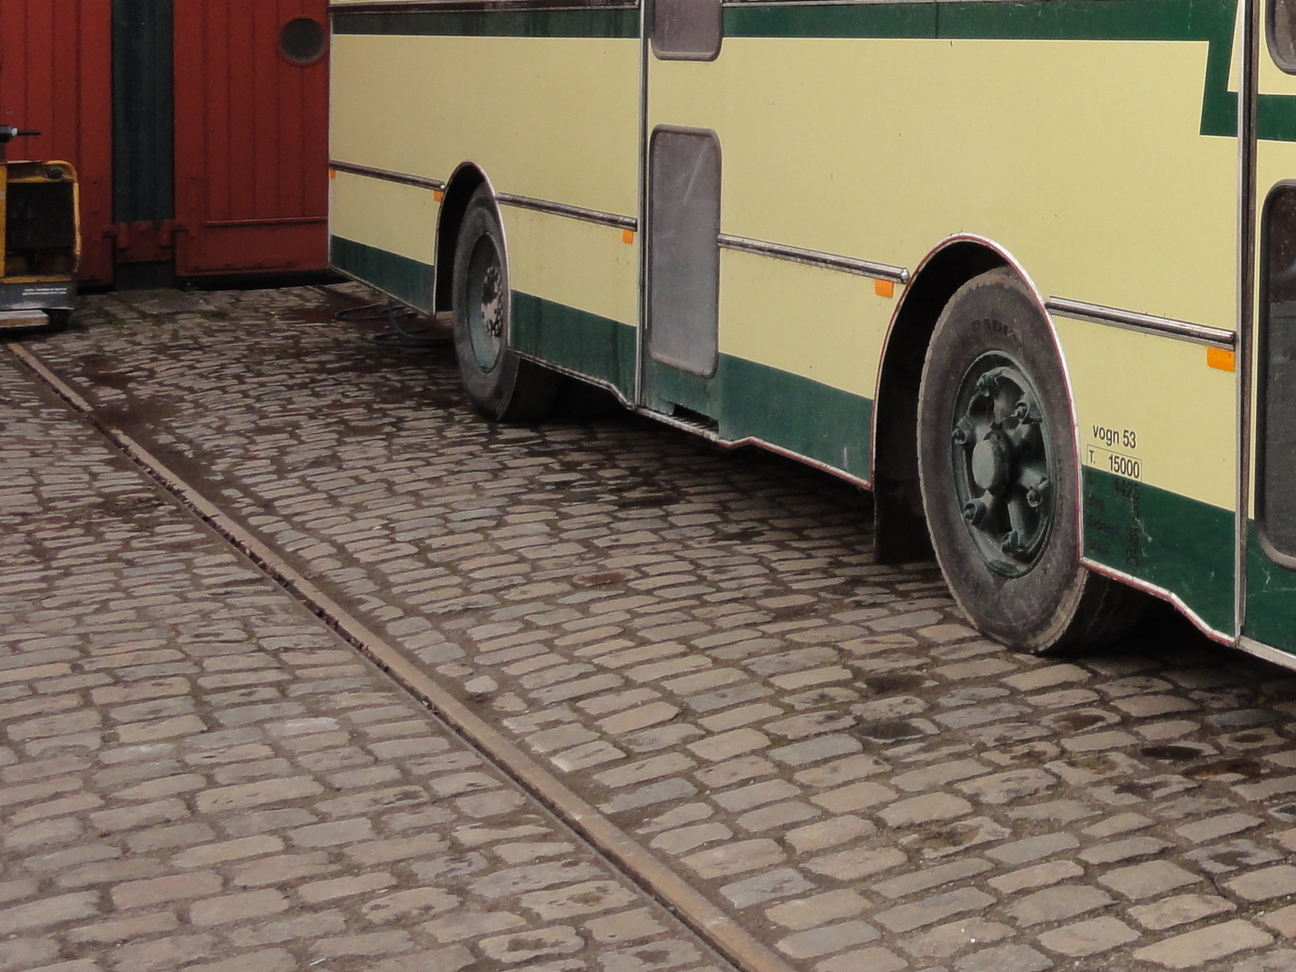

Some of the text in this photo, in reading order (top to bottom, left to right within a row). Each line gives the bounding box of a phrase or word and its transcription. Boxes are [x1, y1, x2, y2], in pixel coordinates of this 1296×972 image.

[1092, 424, 1137, 449] vogn 53
[1108, 454, 1140, 479] 15000
